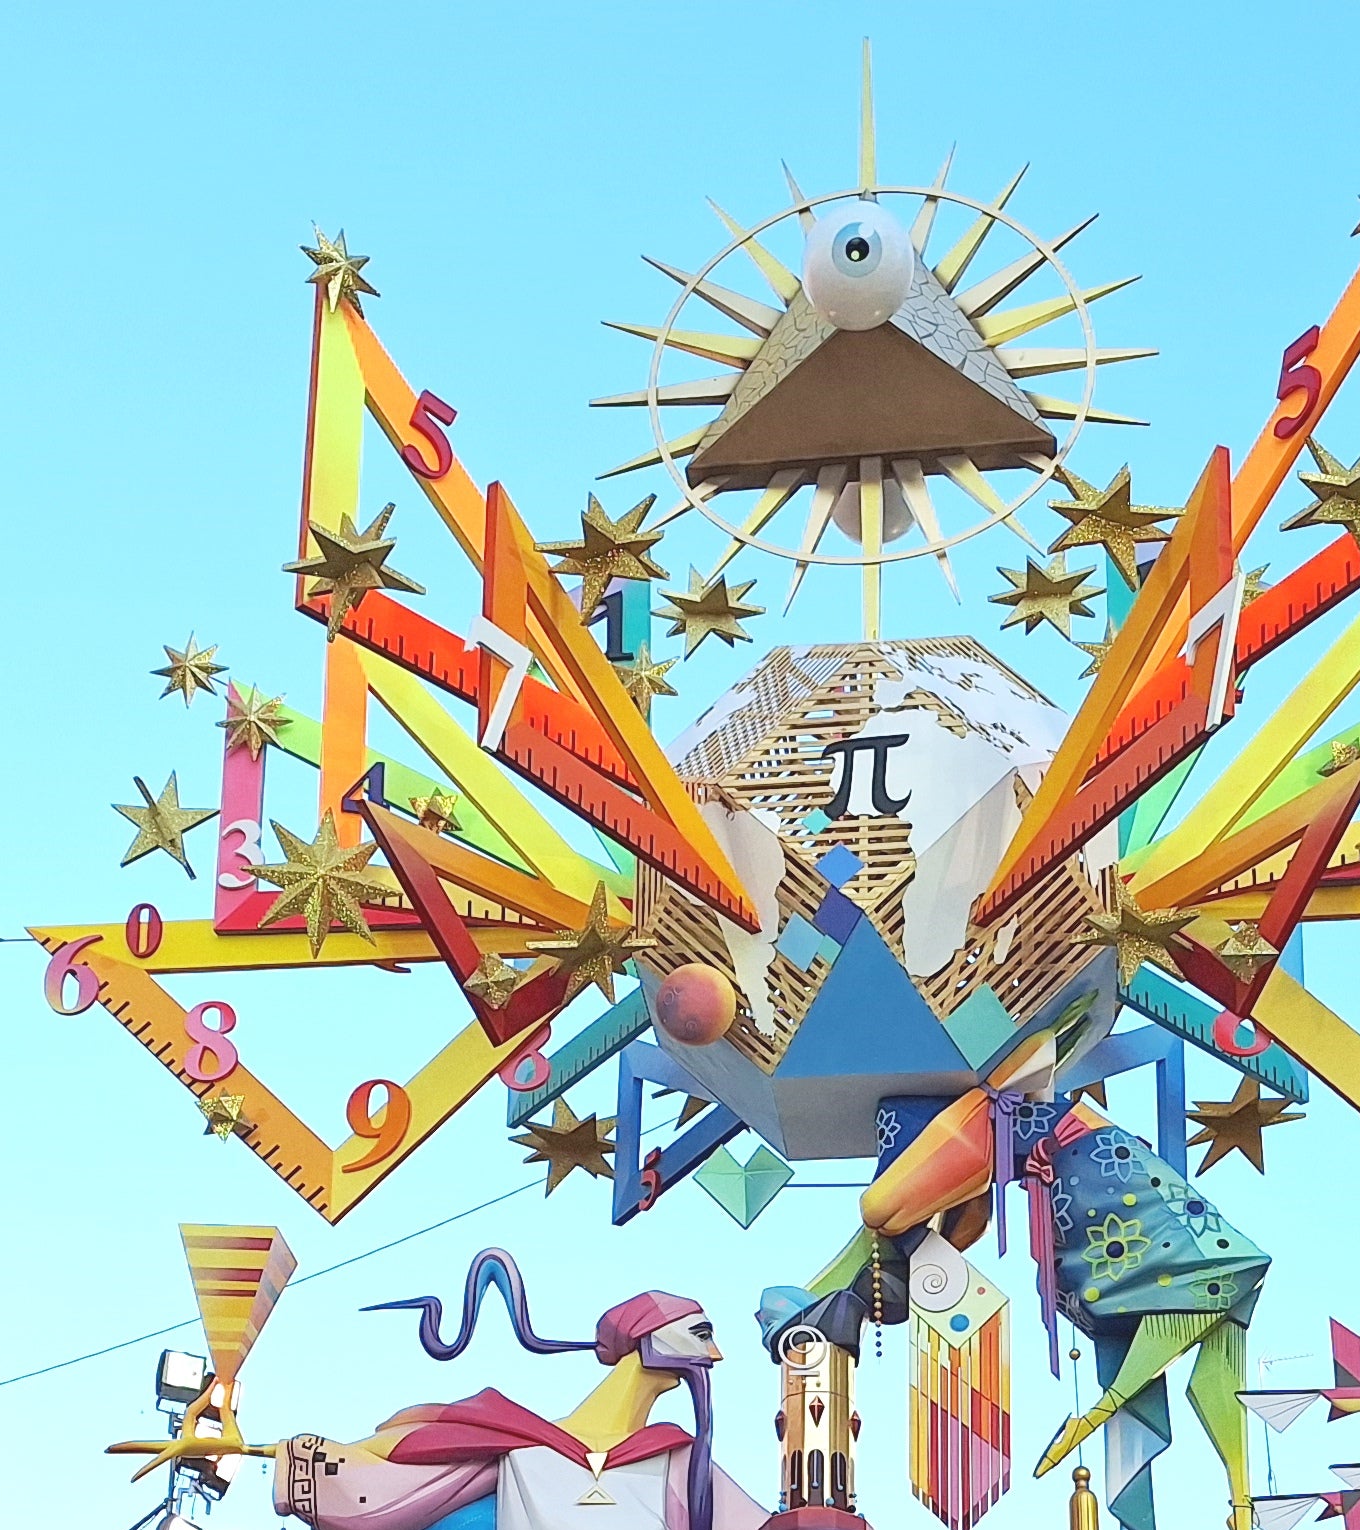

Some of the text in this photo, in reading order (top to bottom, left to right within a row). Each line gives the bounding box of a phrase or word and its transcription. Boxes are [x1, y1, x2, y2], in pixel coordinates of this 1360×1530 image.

[1274, 325, 1321, 439] 5
[402, 390, 458, 480] 5
[464, 615, 534, 751] 7
[1185, 573, 1246, 733] 7
[219, 819, 263, 889] 3
[44, 933, 101, 1015] 6
[183, 1001, 238, 1082] 8
[342, 1079, 411, 1173] 9
